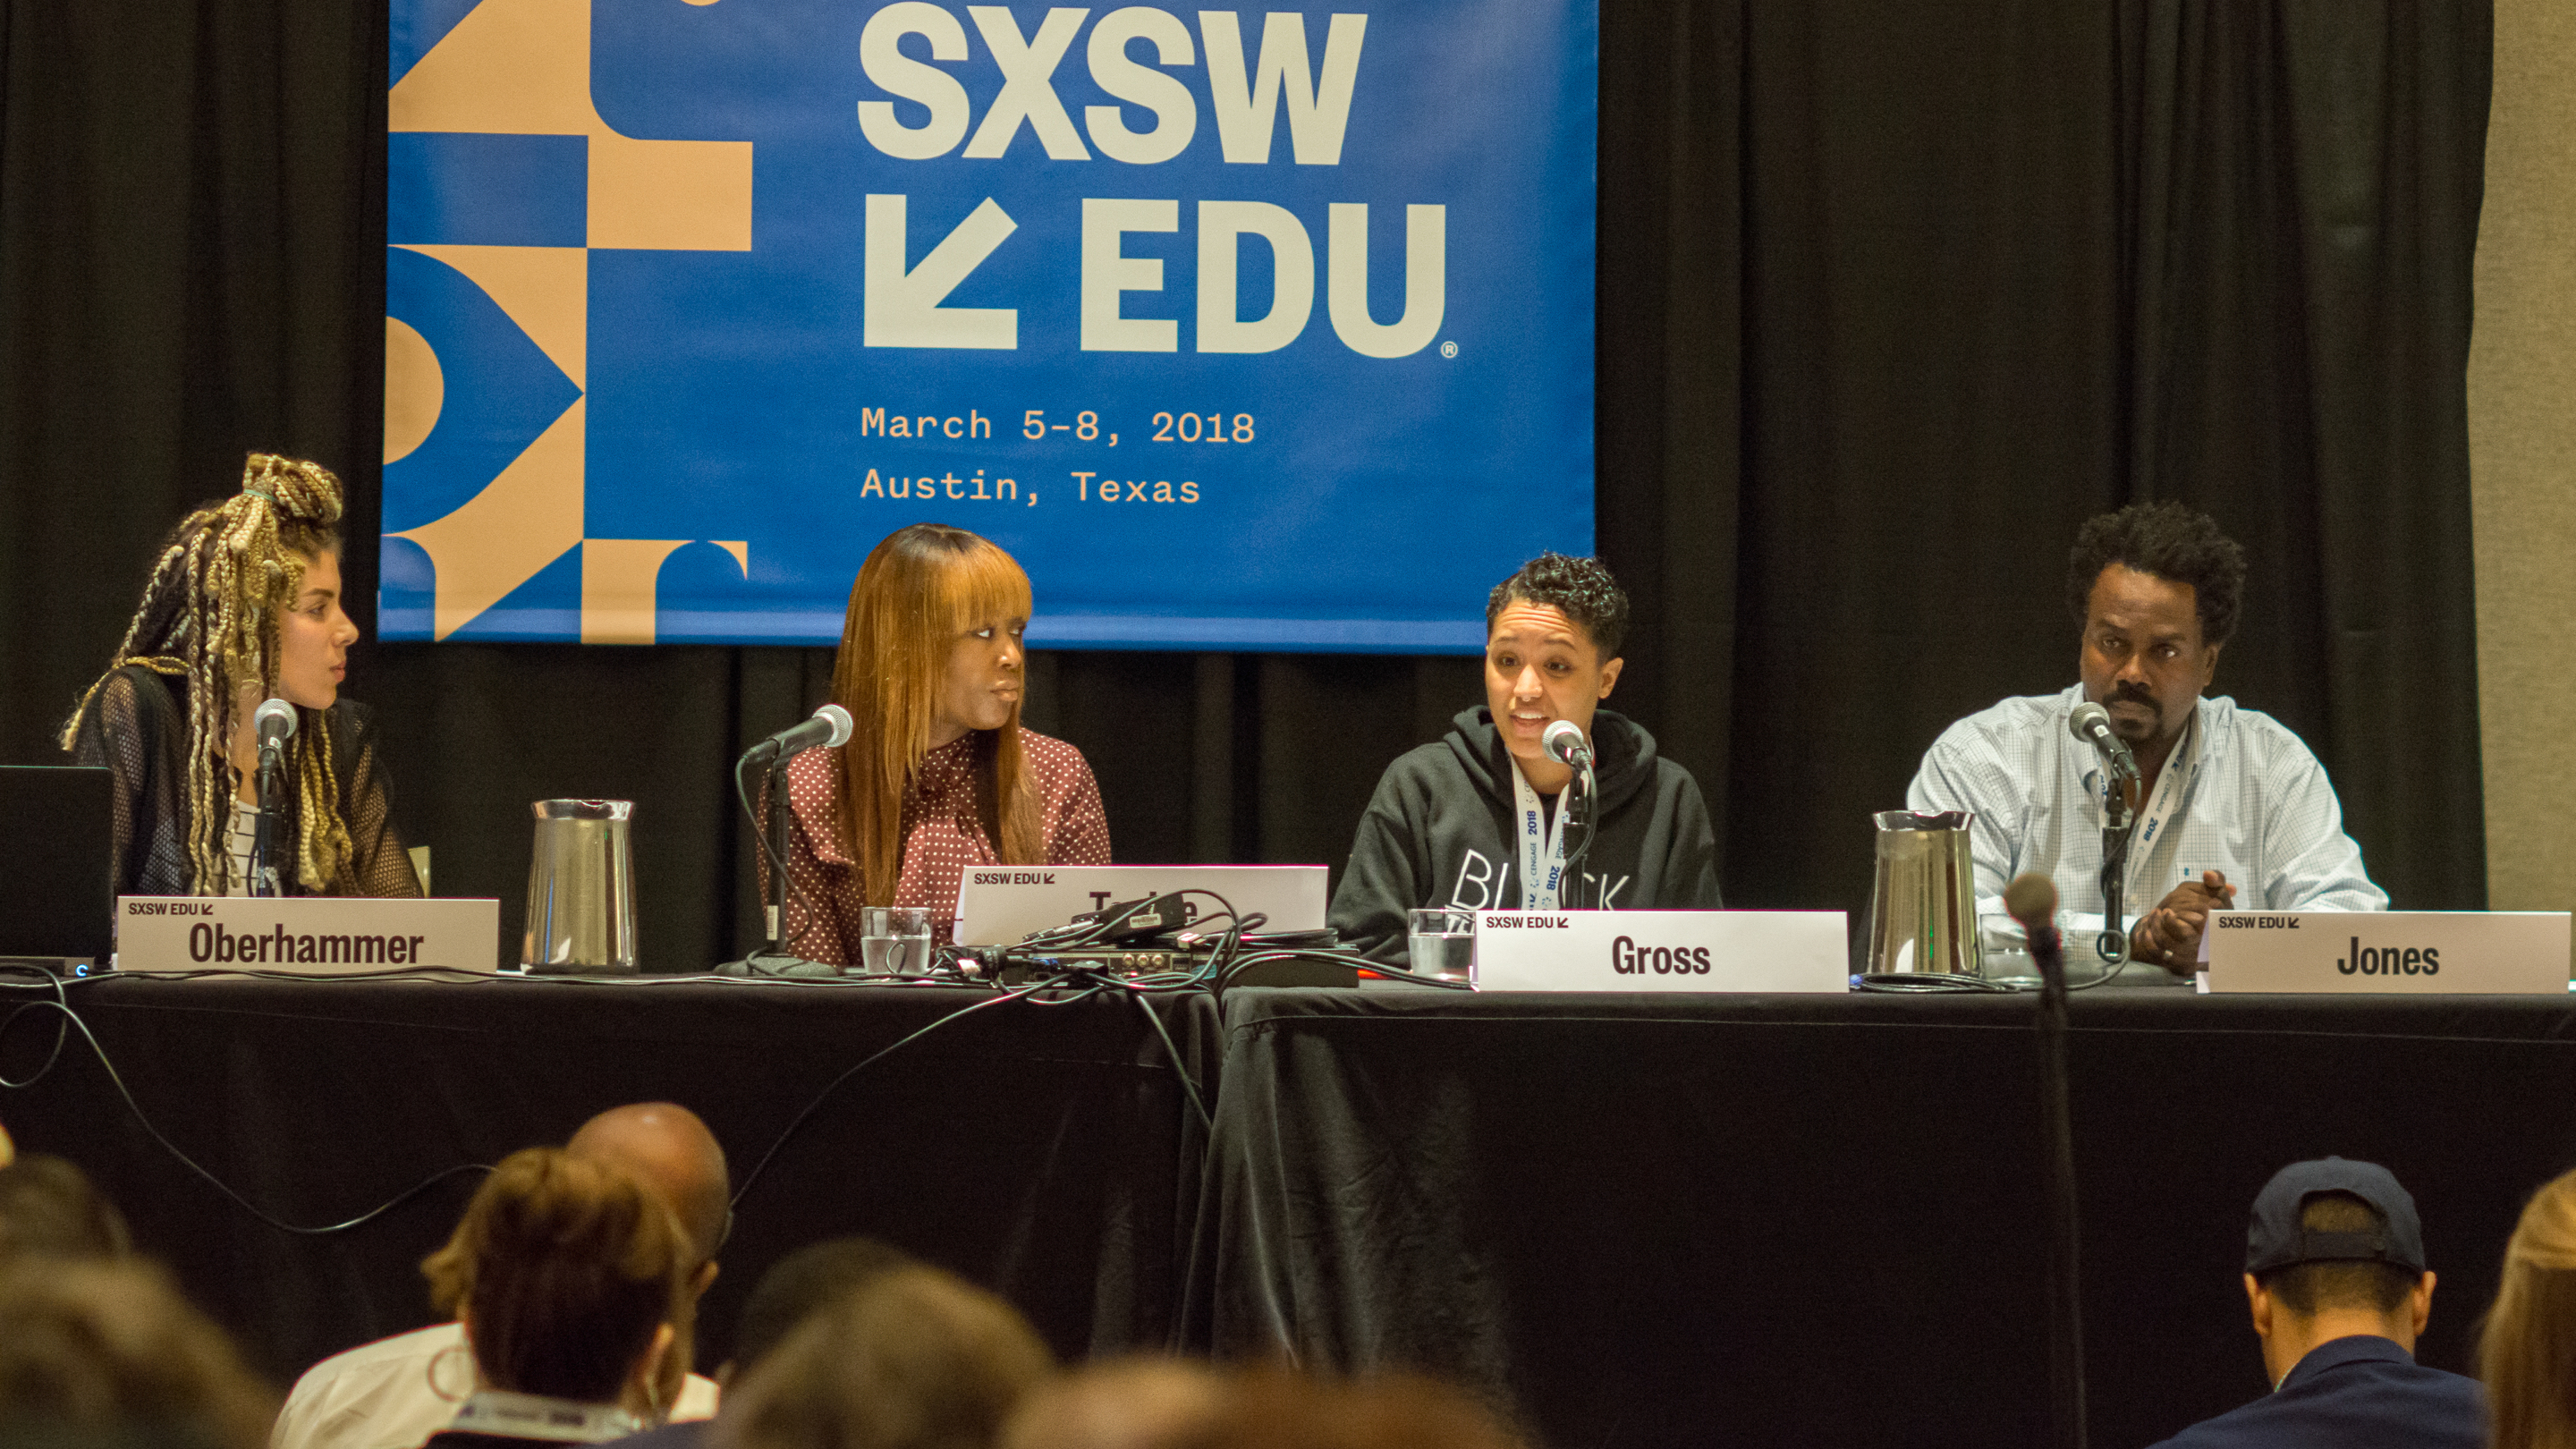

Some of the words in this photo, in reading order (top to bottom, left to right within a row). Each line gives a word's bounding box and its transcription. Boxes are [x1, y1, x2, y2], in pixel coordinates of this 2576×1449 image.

[858, 2, 1368, 166] SXSW
[861, 407, 992, 439] March
[1152, 411, 1256, 445] 2018
[860, 469, 1039, 509] Austin,
[1072, 471, 1201, 504] Texas
[1526, 809, 1538, 836] 2018
[2143, 816, 2159, 843] 2018
[1530, 842, 1538, 877] CENGAGE
[973, 872, 1012, 886] SXSW
[1013, 872, 1041, 886] EDU
[1546, 864, 1561, 892] 2018
[128, 902, 168, 916] SXSW
[170, 902, 199, 916] EDU
[1486, 916, 1524, 929] SXSW
[1526, 916, 1555, 929] EDU
[2218, 916, 2256, 929] SXSW
[2258, 916, 2285, 929] EDU
[189, 922, 425, 963] Oberhammer
[1612, 935, 1711, 975] Gross
[2336, 936, 2440, 976] Jones
